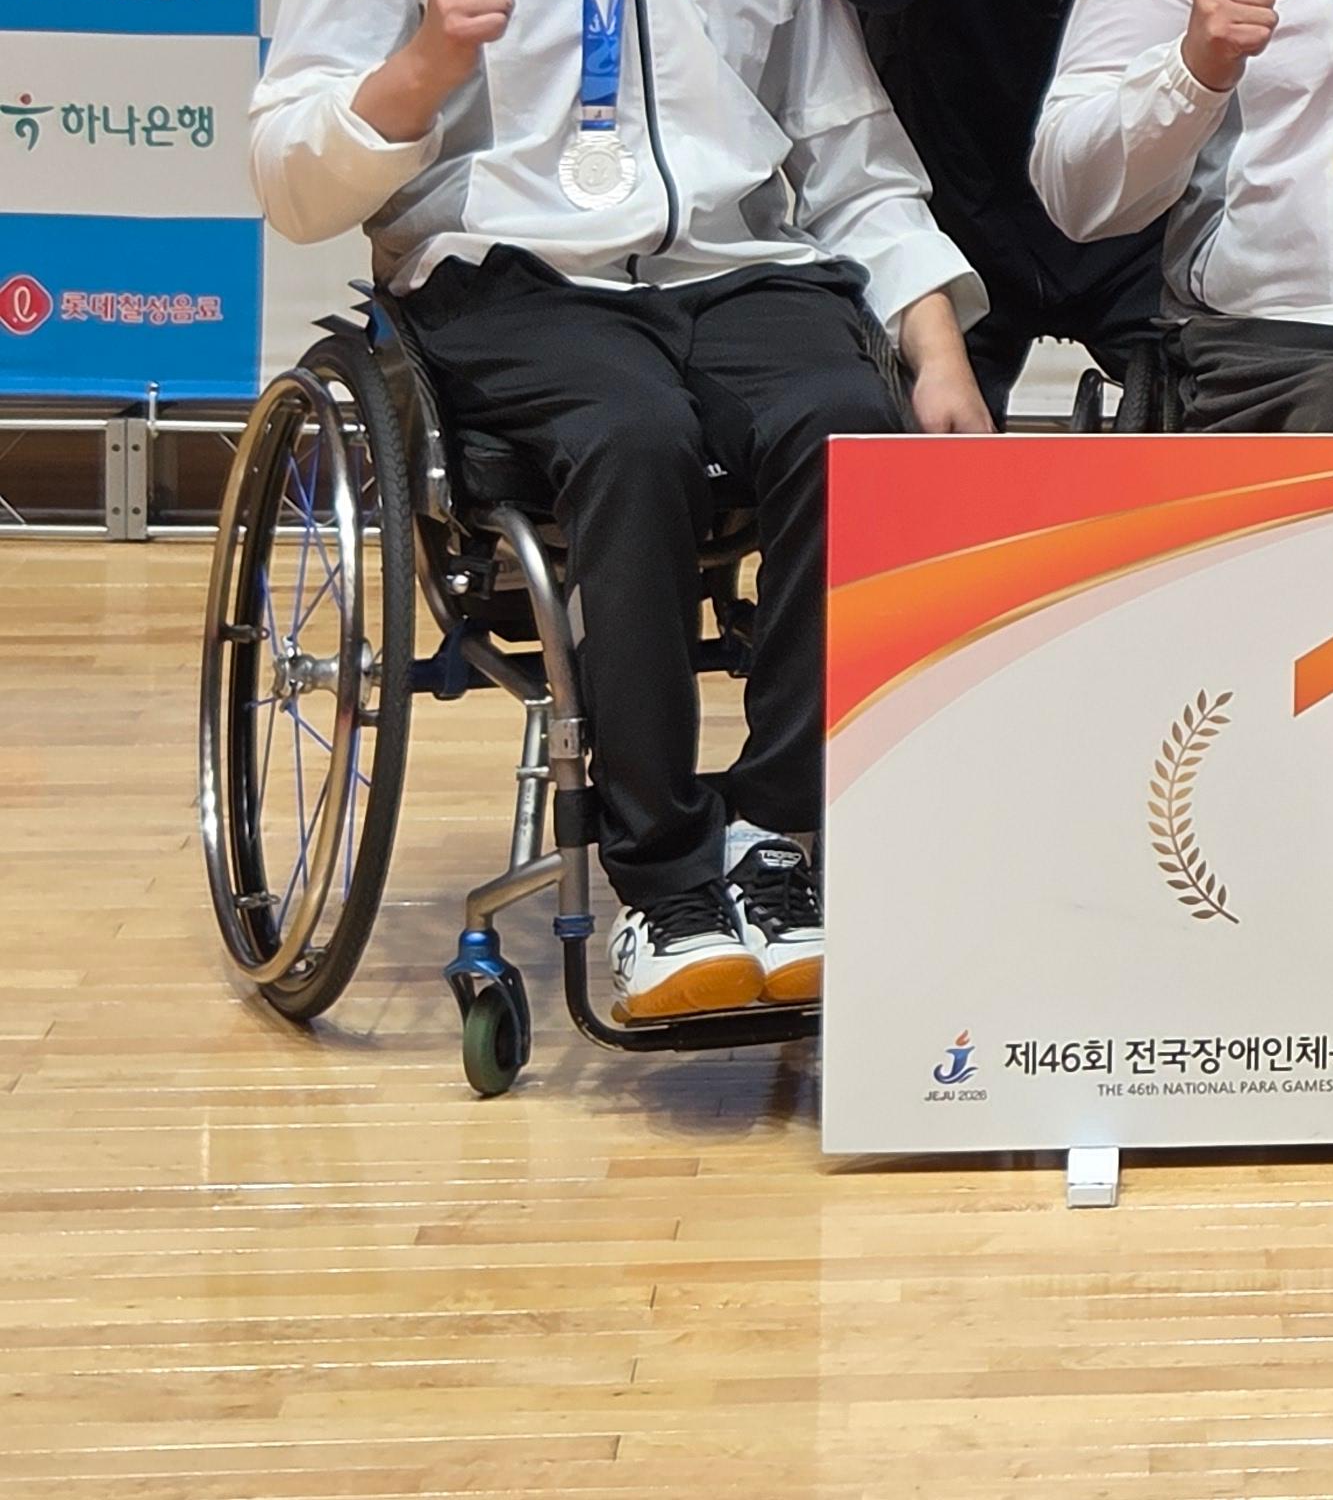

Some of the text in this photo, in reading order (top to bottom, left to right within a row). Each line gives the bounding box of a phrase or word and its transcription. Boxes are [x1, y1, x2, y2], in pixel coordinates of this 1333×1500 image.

[61, 102, 215, 149] 하나은행
[60, 291, 224, 322] 롯데칠성음료
[1004, 1037, 1114, 1075] 제46회
[1097, 1084, 1124, 1097] THE
[1127, 1082, 1160, 1097] 46th
[1162, 1081, 1237, 1096] NATIONAL
[1239, 1080, 1278, 1095] PARA
